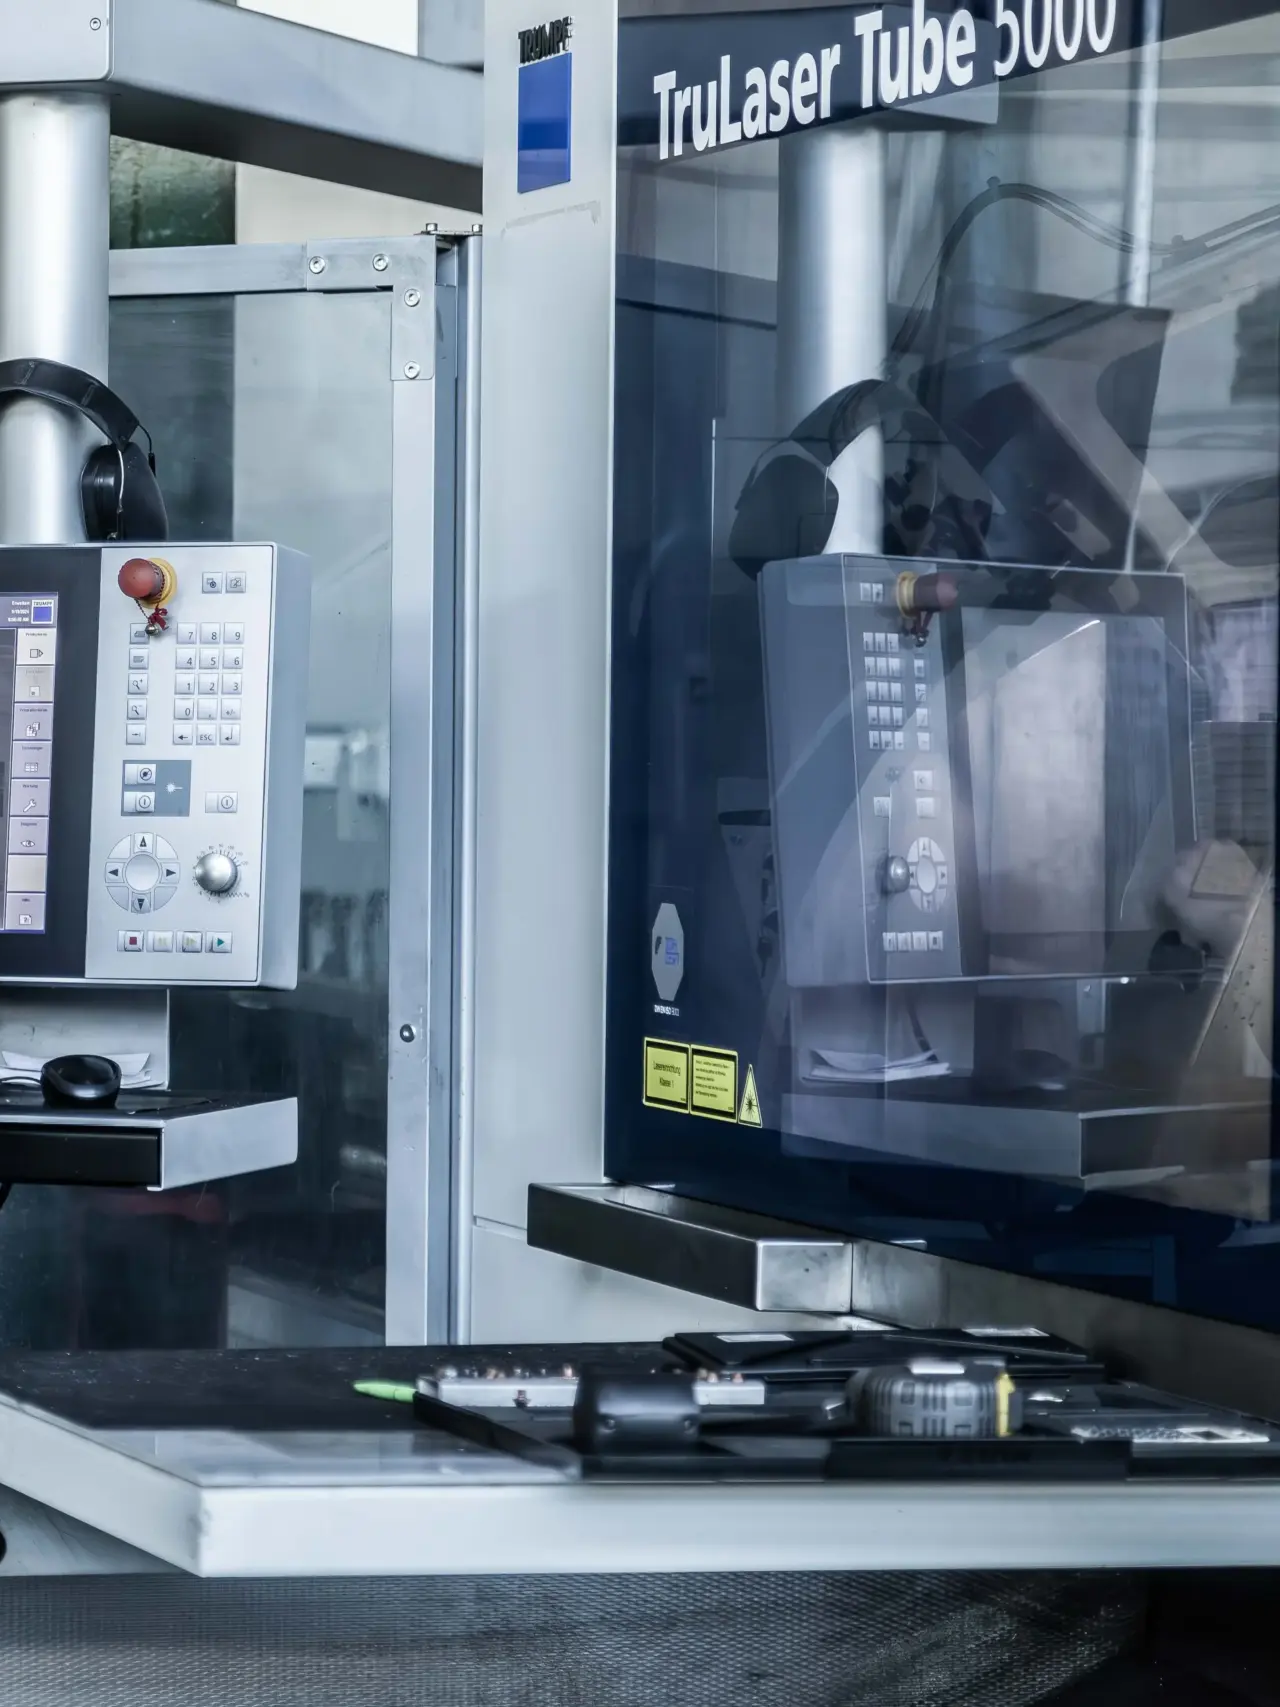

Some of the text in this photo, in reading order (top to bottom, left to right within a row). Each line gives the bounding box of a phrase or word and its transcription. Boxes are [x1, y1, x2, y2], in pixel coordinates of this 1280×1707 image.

[518, 16, 573, 64] TRUMPF
[653, 43, 841, 160] TruLaser
[853, 0, 977, 108] Tube
